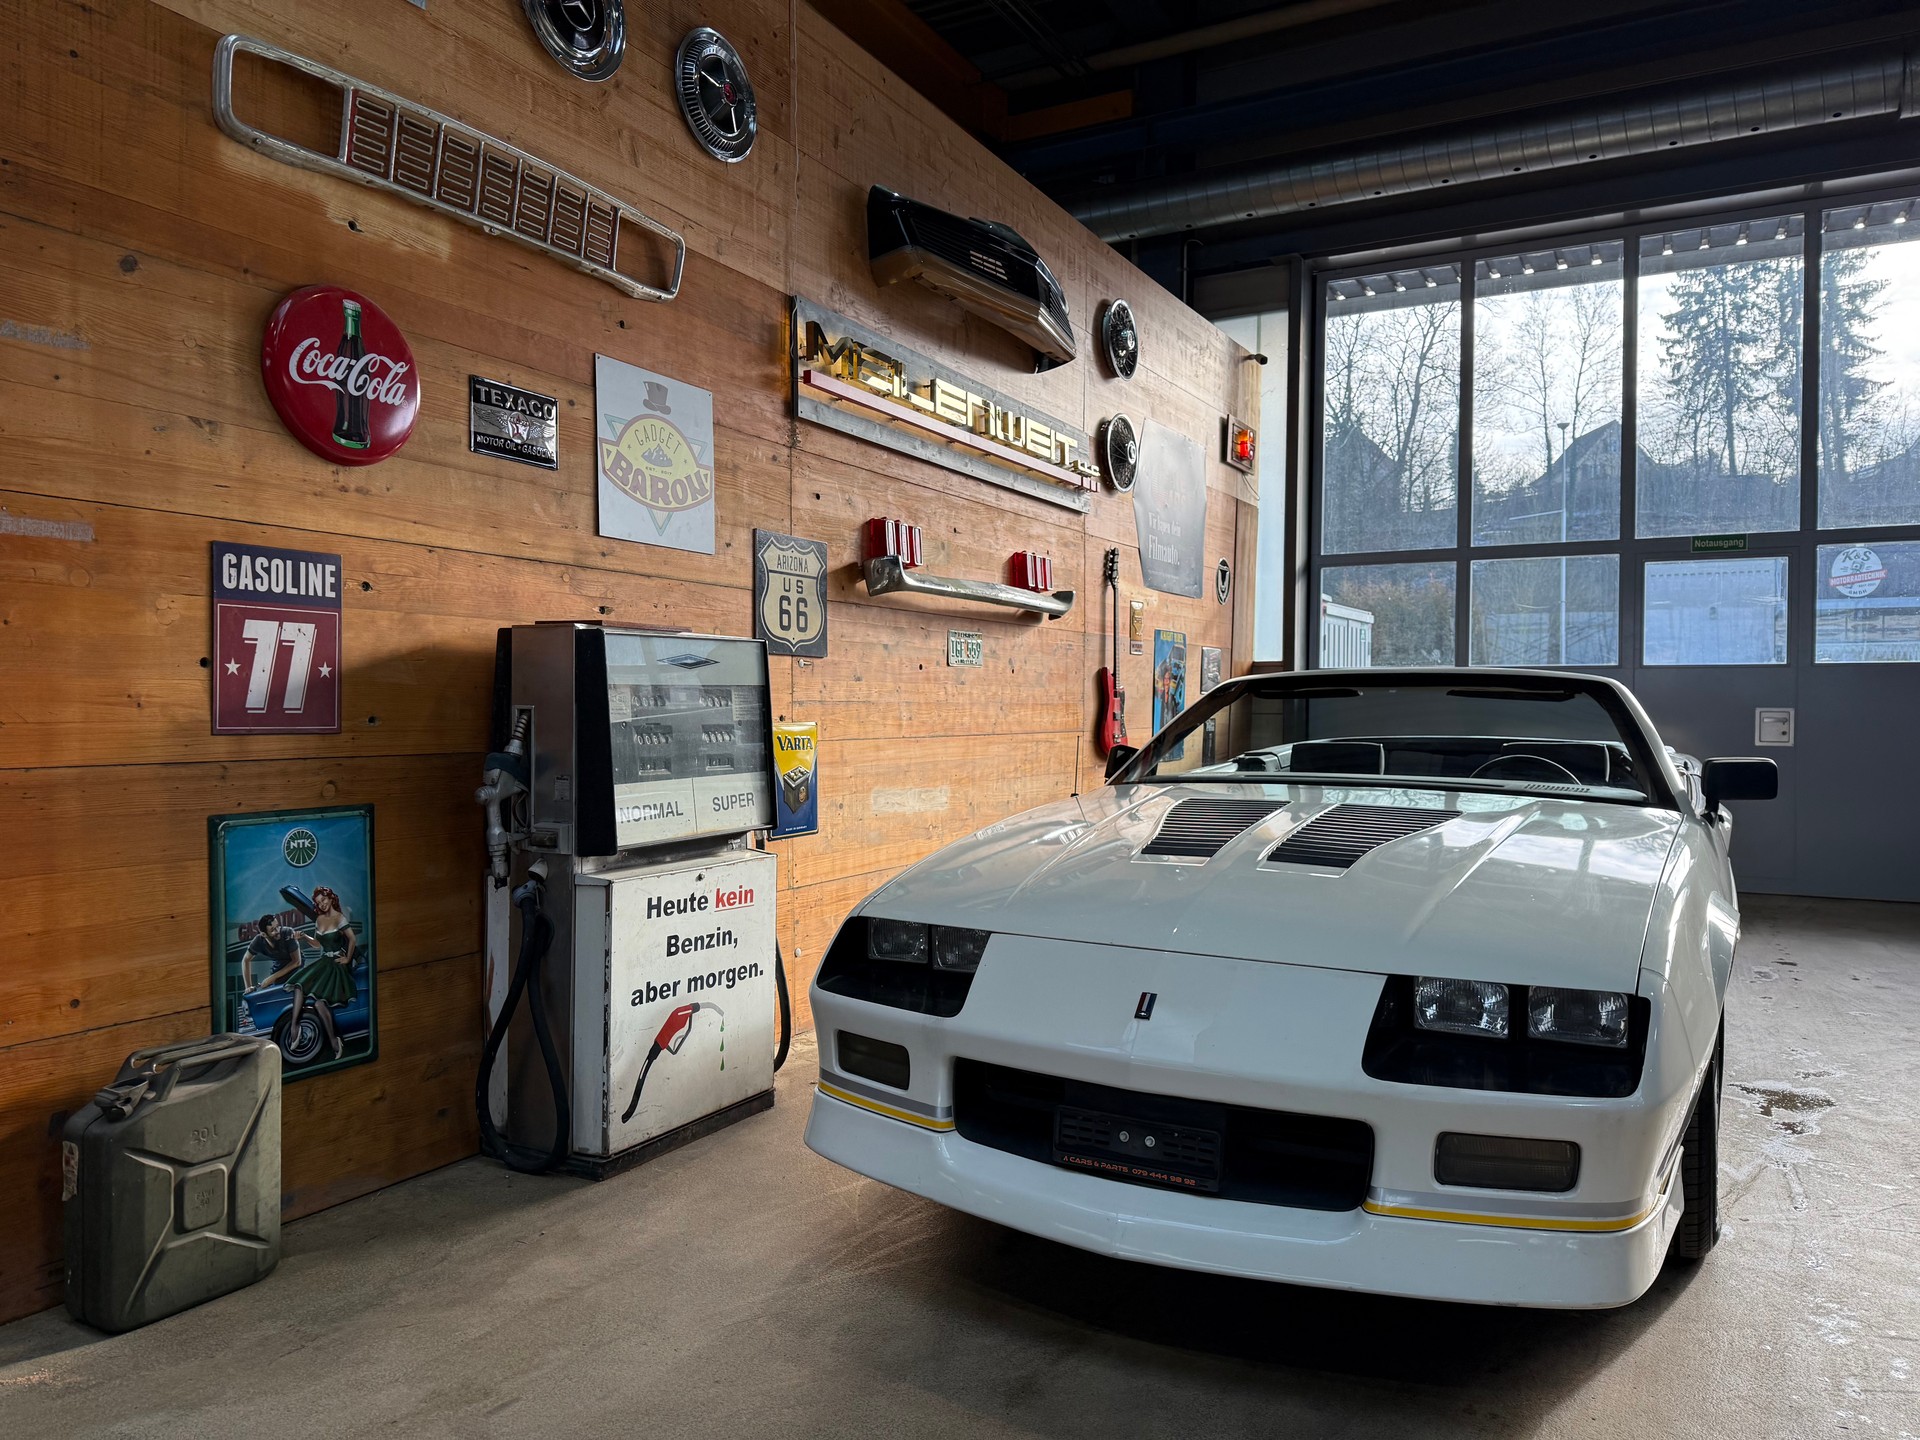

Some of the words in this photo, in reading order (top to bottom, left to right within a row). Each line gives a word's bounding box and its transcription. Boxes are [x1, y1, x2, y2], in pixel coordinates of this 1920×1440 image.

[288, 337, 410, 406] Coca-Cola
[475, 384, 555, 420] TEXACO
[476, 434, 504, 448] MOTOR
[505, 441, 517, 451] OIL
[634, 424, 682, 455] GADGET
[606, 448, 709, 506] BARON
[1694, 539, 1744, 549] Notausgang
[1841, 549, 1872, 563] K&S
[776, 553, 809, 573] ARIZONA
[222, 553, 336, 599] GASOLINE
[783, 577, 804, 595] US
[1830, 569, 1887, 587] MOTORRADTECHNIK
[779, 594, 809, 633] 66
[776, 735, 814, 752] VARTA
[619, 801, 684, 824] NORMAL
[712, 792, 755, 812] SUPER
[290, 838, 312, 850] NTK
[646, 892, 709, 919] Heute
[715, 885, 754, 909] kein
[666, 927, 738, 957] Benzin,
[630, 979, 681, 1007] aber
[687, 962, 763, 989] morgen.
[1069, 1156, 1093, 1166] CARS
[1101, 1162, 1129, 1173] PARTS
[1132, 1168, 1148, 1177] 079
[1149, 1172, 1168, 1181] 444
